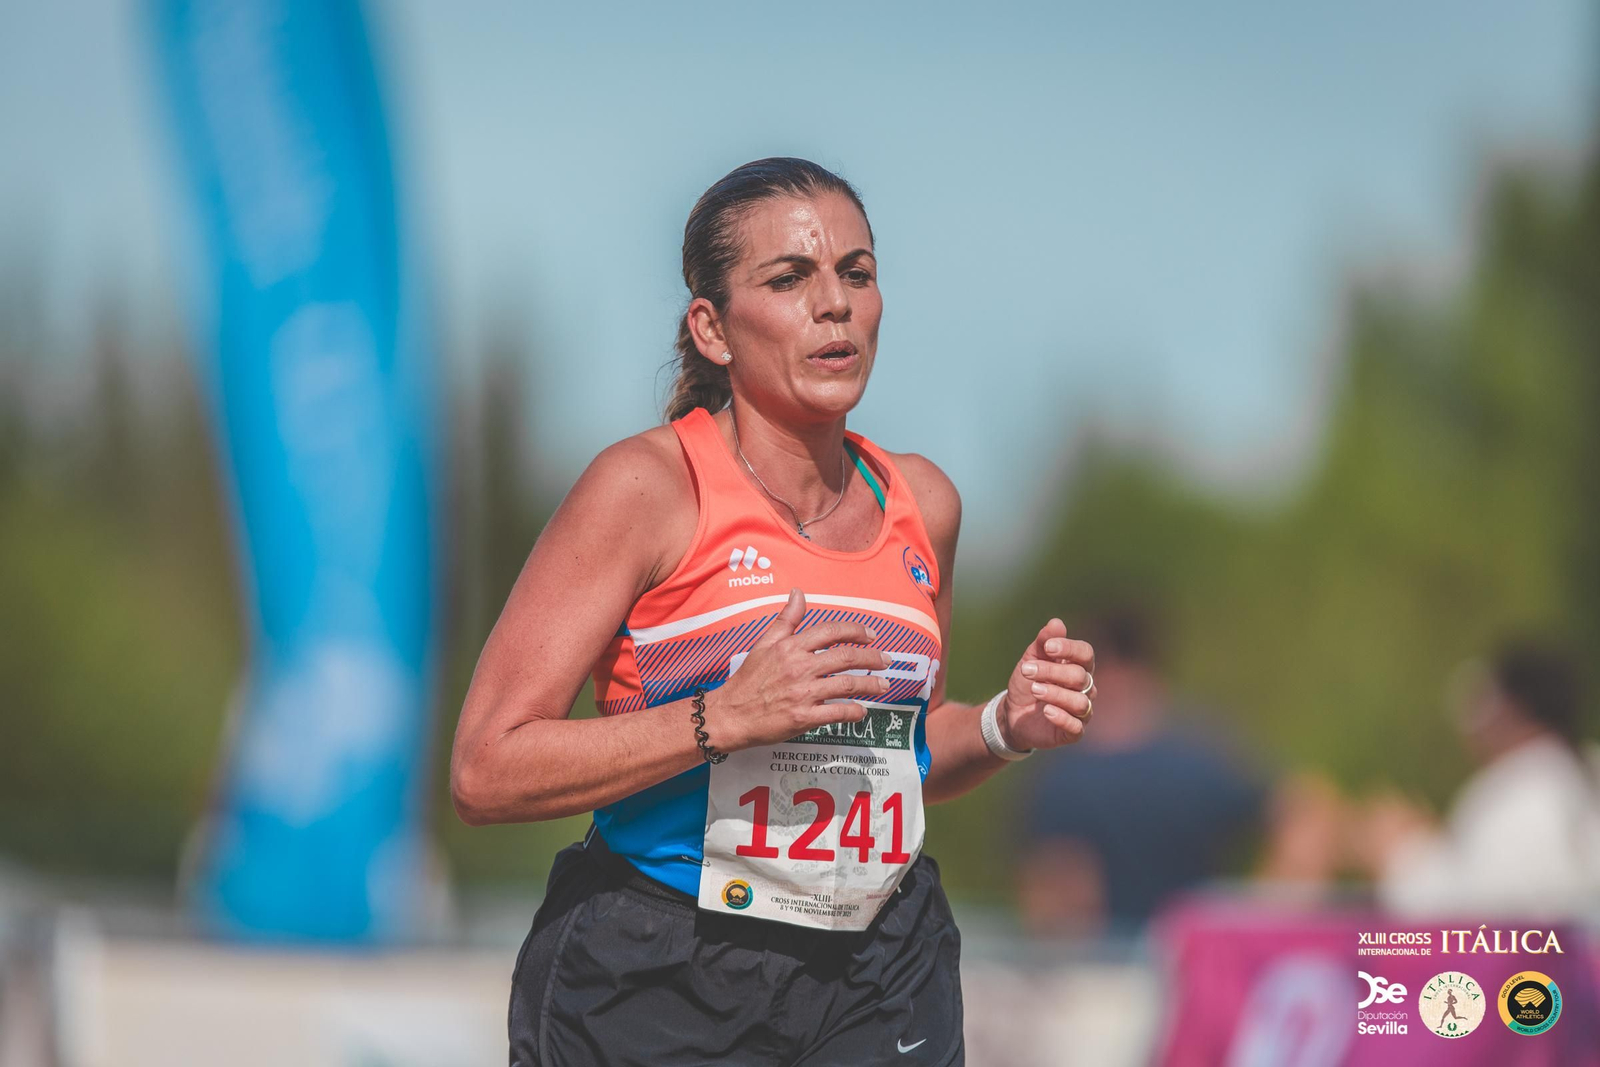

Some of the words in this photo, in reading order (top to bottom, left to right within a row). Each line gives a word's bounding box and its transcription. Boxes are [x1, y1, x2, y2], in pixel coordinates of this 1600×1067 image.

[728, 572, 774, 588] mobel
[772, 751, 828, 762] MERCEDES
[830, 753, 858, 764] MATEO
[770, 763, 798, 773] CLUB
[800, 764, 828, 774] CAPA
[858, 767, 890, 777] ALCORES
[736, 785, 911, 864] 1241
[791, 899, 837, 910] INTERNACIONAL
[804, 908, 836, 917] NOVIEMBRE
